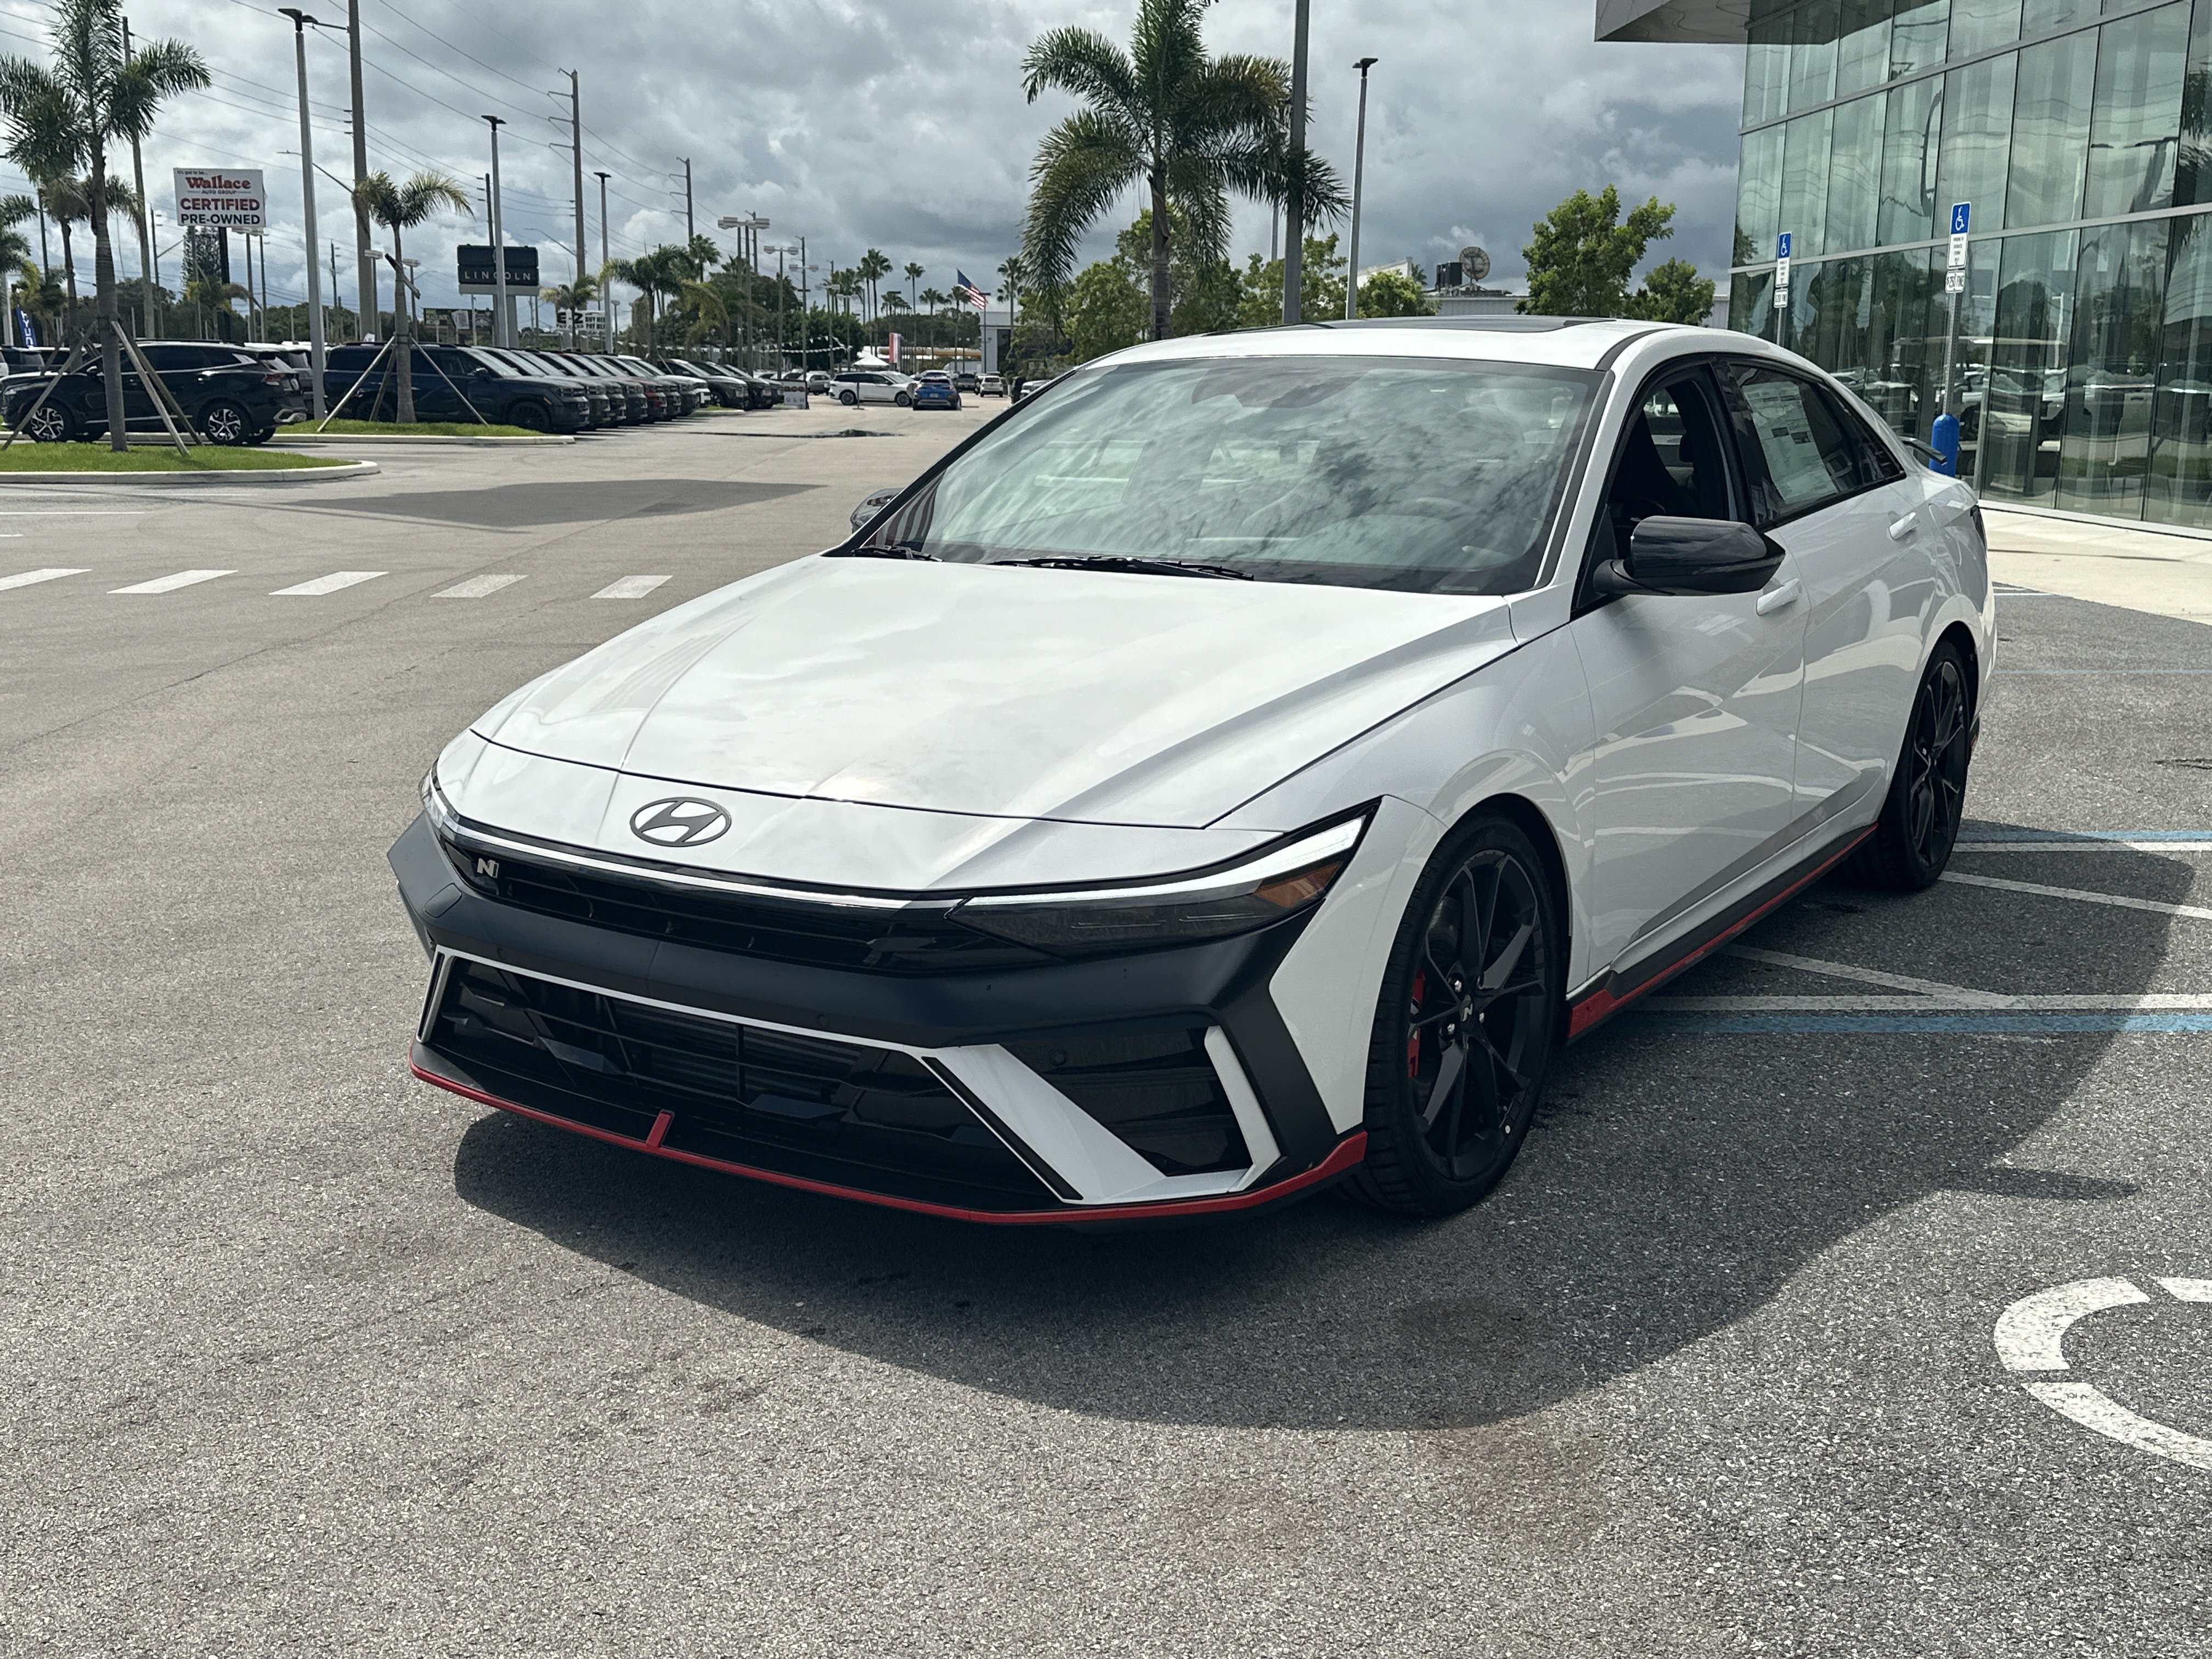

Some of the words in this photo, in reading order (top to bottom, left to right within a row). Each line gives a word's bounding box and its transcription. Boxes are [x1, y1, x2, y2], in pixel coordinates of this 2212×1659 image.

[185, 174, 252, 189] Wallace
[180, 198, 260, 211] CERTIFIED
[180, 213, 260, 224] PRE-OWNED
[477, 857, 499, 878] N
